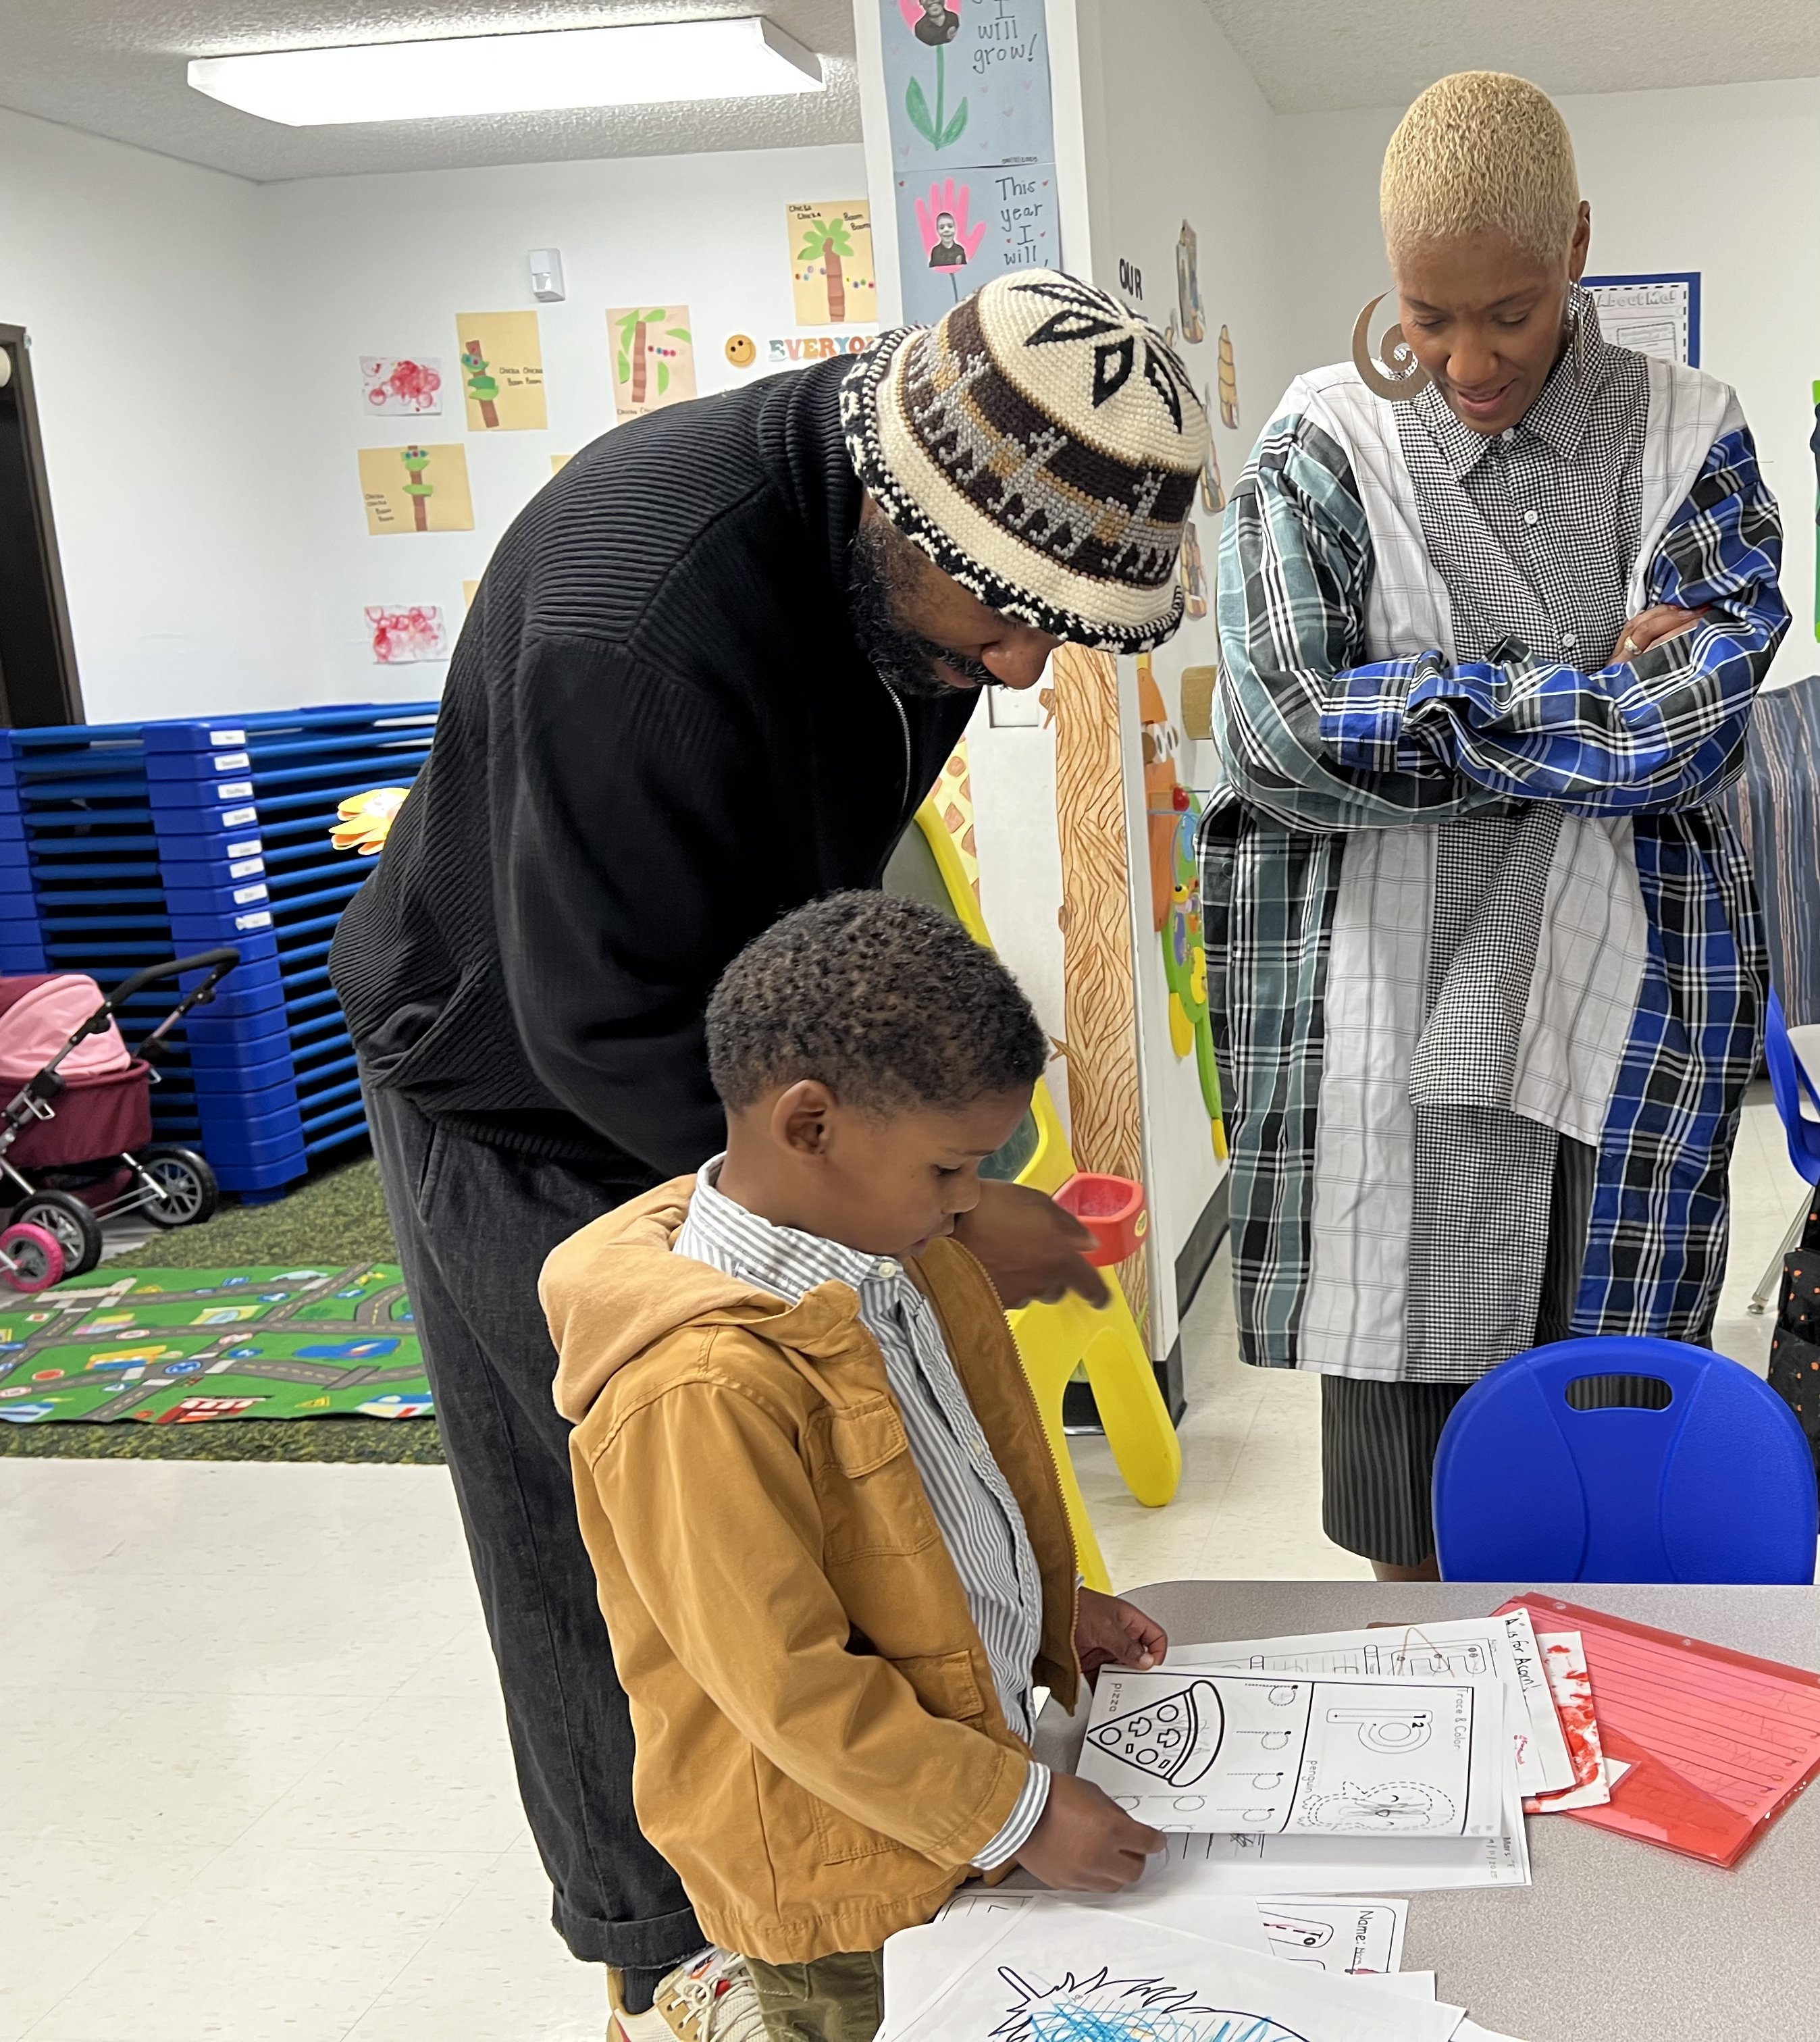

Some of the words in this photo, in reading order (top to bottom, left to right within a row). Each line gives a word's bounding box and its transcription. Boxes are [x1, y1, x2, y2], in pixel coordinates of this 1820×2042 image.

[995, 0, 1015, 20] I
[979, 20, 1018, 41] will
[972, 33, 1038, 74] grow!
[995, 177, 1037, 201] This
[1000, 202, 1043, 232] year
[1017, 225, 1035, 245] I
[1004, 246, 1037, 266] will
[1119, 257, 1143, 300] OUR
[1597, 292, 1644, 308] About
[1646, 290, 1677, 305] Me!
[769, 336, 875, 362] EVERYO
[1507, 1631, 1518, 1639] is
[1511, 1640, 1530, 1653] for
[1514, 1658, 1542, 1693] Acorn!
[1109, 1681, 1122, 1713] pizza
[1455, 1687, 1470, 1714] Trace
[1301, 1760, 1318, 1794] penguin
[1501, 1837, 1511, 1857] Mars
[1355, 1910, 1374, 1945] Name:
